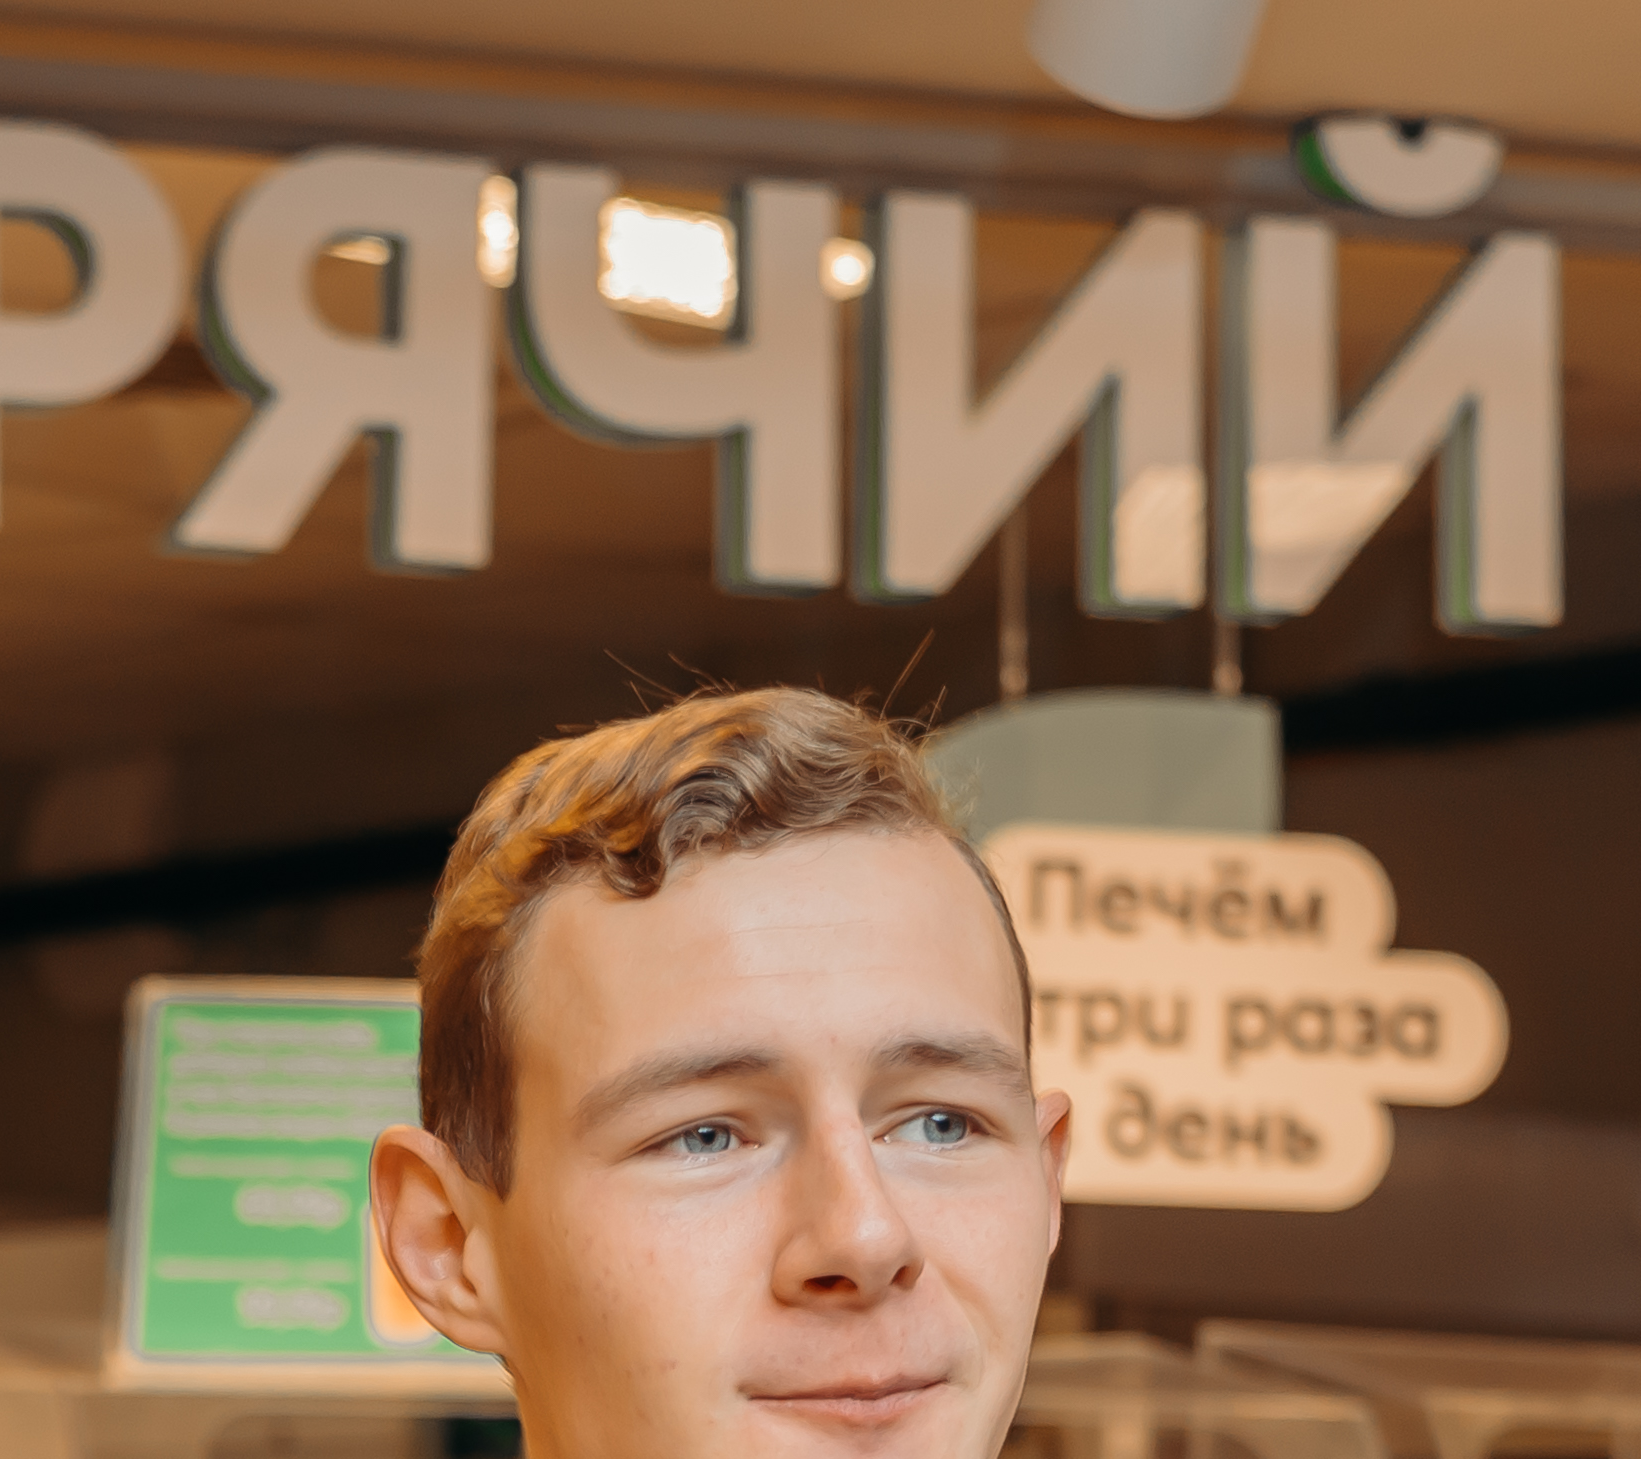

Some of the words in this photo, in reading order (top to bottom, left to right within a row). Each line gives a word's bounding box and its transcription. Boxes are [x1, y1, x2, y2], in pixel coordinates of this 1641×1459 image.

[1027, 858, 1324, 940] Печём
[1225, 1000, 1441, 1071] раза
[1107, 1082, 1322, 1162] день
